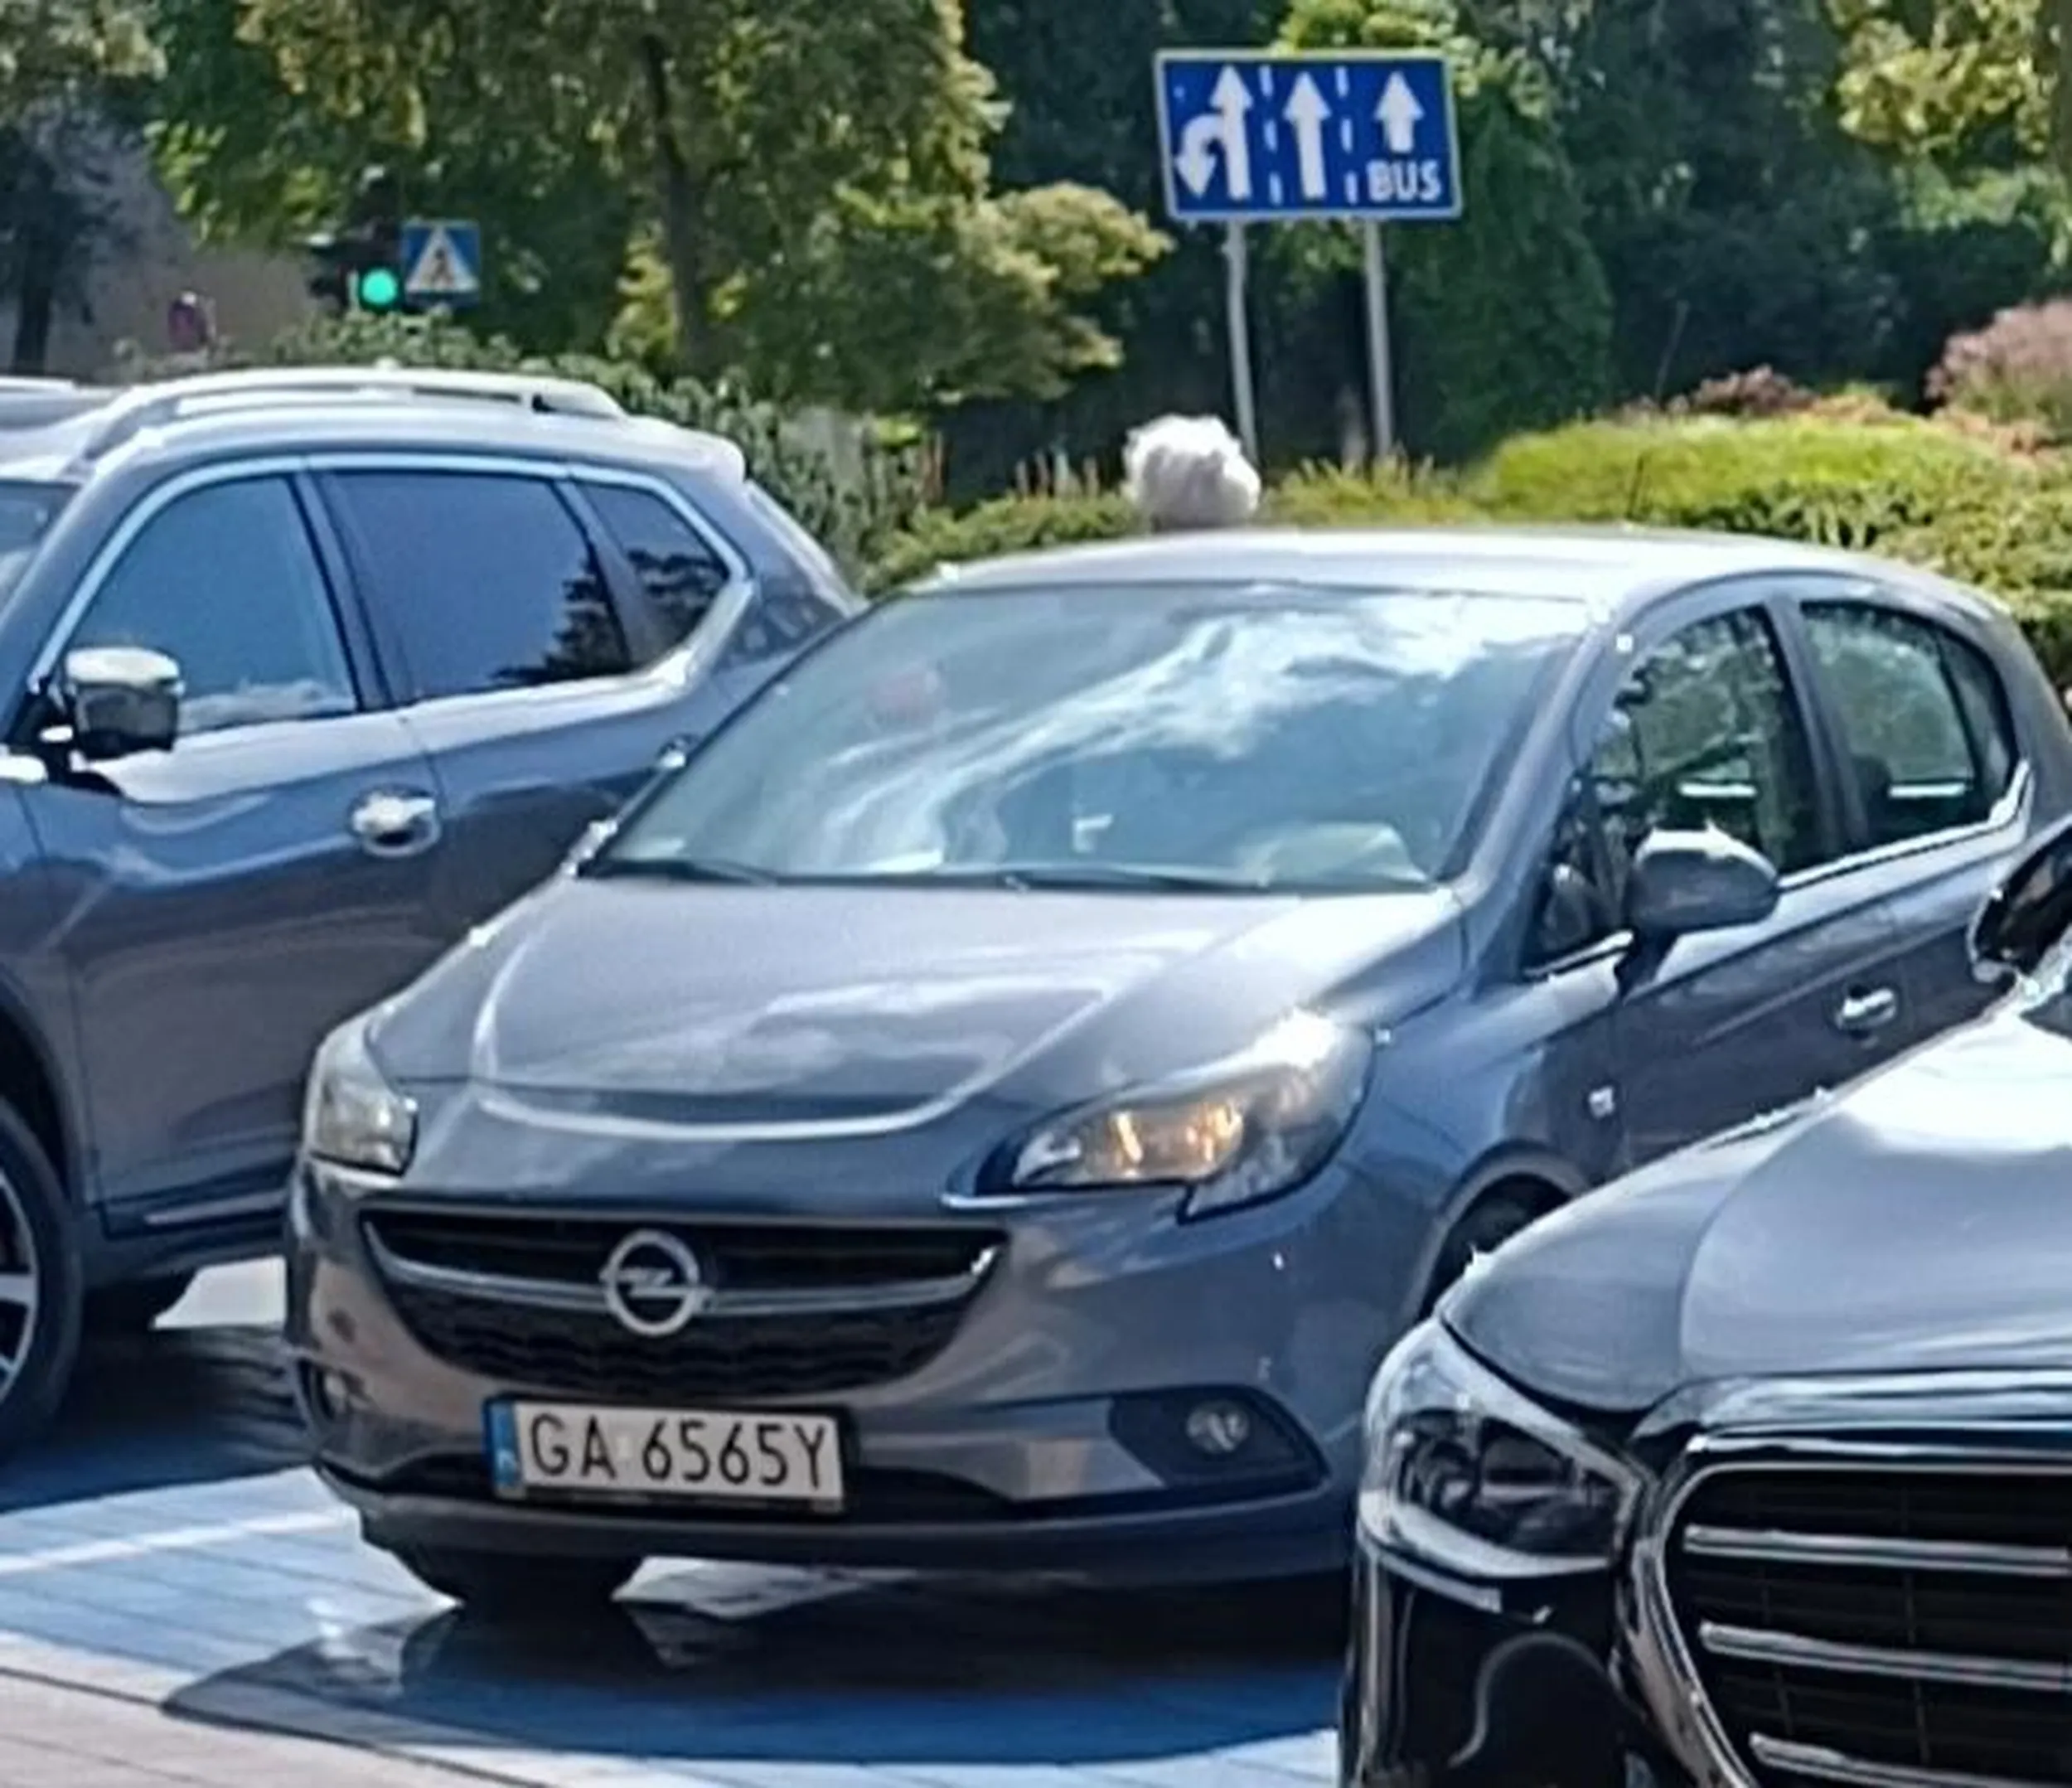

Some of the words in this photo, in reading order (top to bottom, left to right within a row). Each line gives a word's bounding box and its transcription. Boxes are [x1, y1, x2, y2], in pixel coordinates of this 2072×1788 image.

[1367, 159, 1442, 202] BUS
[530, 1412, 617, 1480] GA
[641, 1417, 825, 1490] 6565Y
